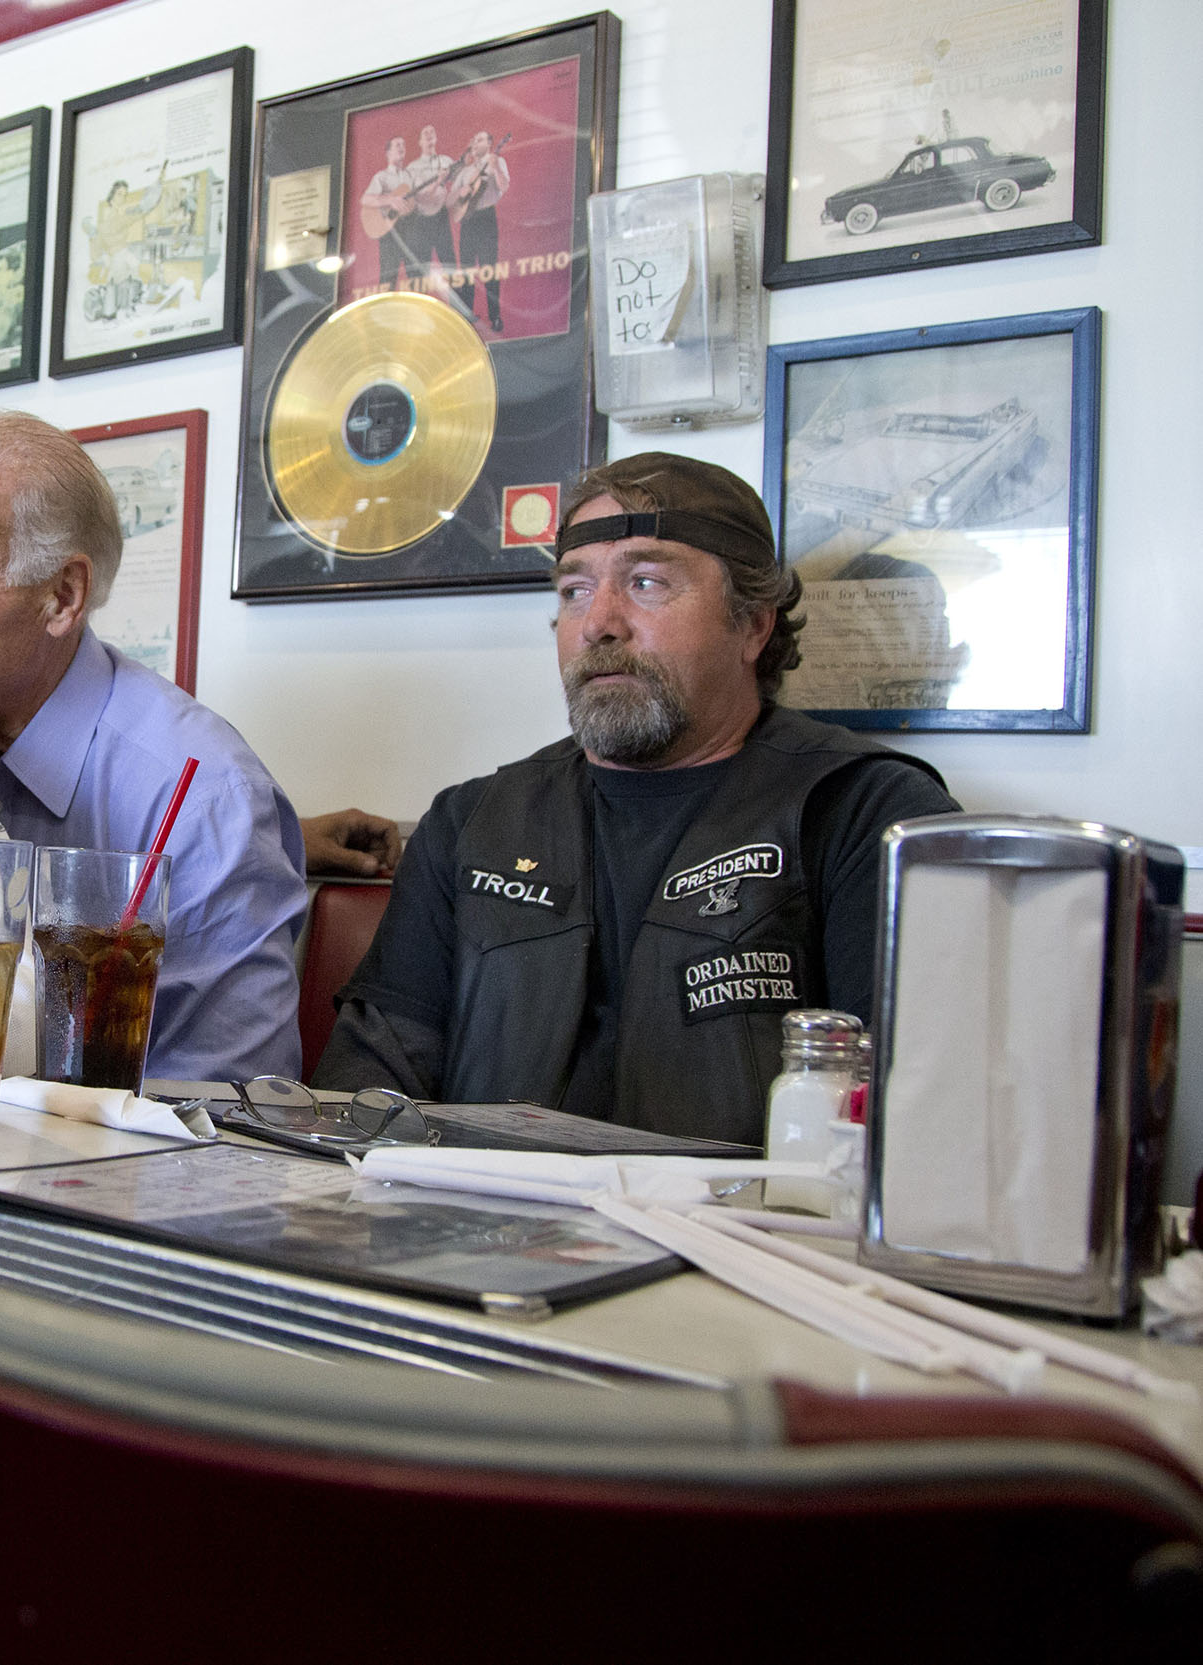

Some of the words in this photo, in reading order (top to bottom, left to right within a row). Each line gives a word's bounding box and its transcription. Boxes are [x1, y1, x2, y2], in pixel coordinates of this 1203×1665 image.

[399, 260, 510, 293] KINSTON
[517, 251, 570, 277] TRIO
[611, 257, 658, 286] Do
[616, 279, 663, 314] not
[839, 589, 857, 600] for
[471, 870, 555, 907] TROLL
[675, 852, 773, 894] PRESIDENT
[685, 951, 792, 987] ORDAINED
[687, 978, 799, 1013] MINISTER
